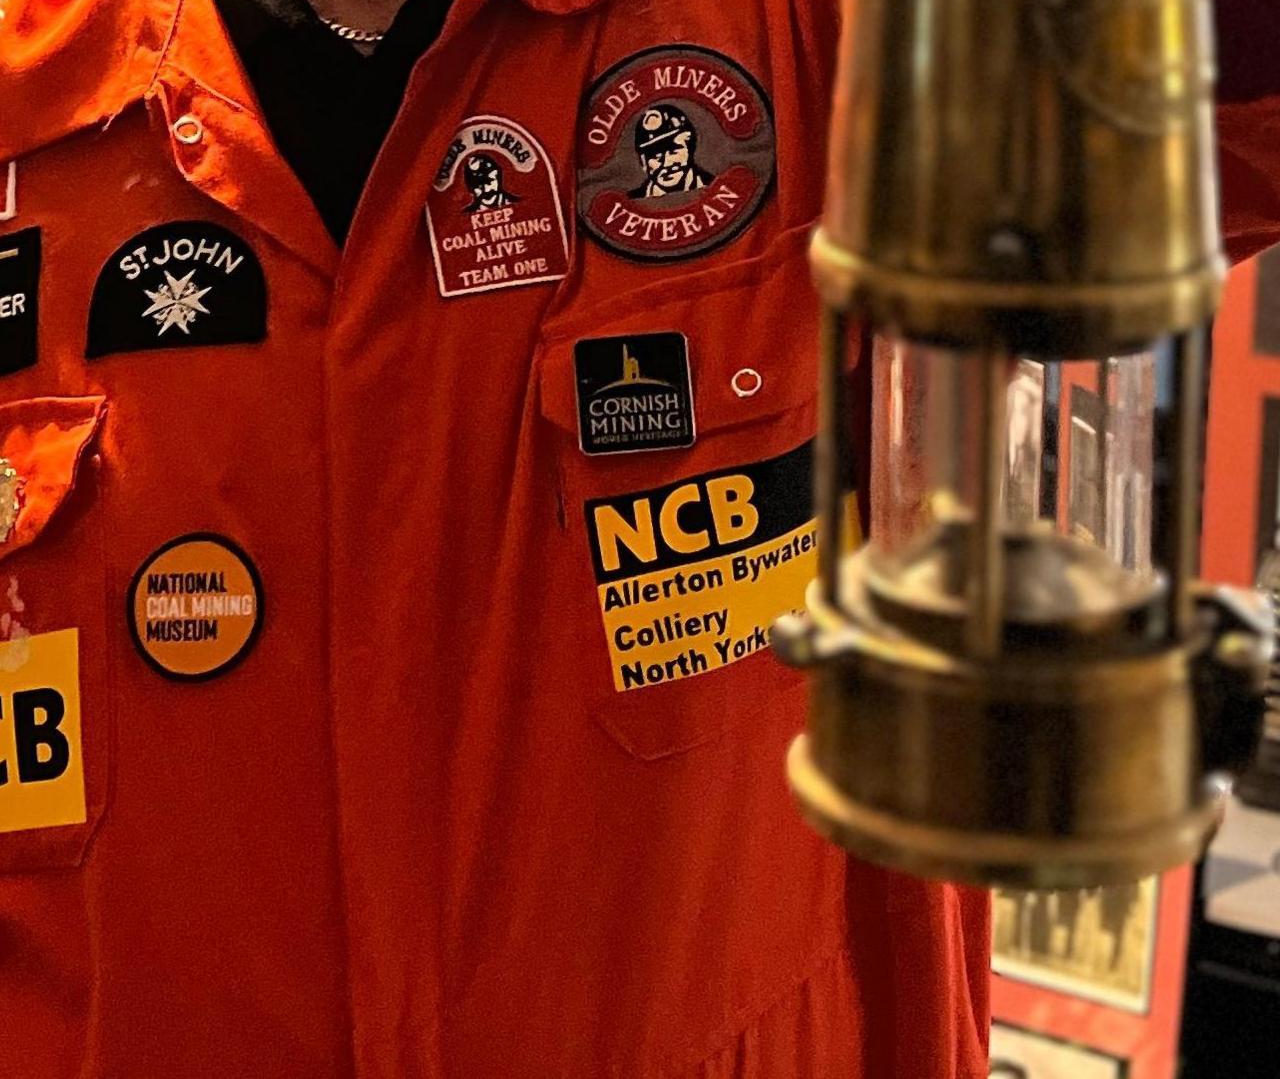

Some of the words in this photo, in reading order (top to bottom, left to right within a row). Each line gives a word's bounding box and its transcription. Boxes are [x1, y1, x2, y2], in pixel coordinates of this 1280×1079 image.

[588, 81, 641, 145] OLDE
[654, 65, 747, 123] MINERS
[471, 208, 514, 229] KEEP
[602, 184, 740, 241] VETERAN
[442, 233, 487, 251] COAL
[490, 218, 552, 244] MINING
[153, 238, 244, 274] JOHN
[476, 240, 526, 263] ALIVE
[459, 265, 509, 288] TEAM
[514, 258, 548, 276] ONE
[589, 393, 679, 417] CORNISH
[591, 411, 681, 435] MINING
[594, 474, 759, 572] NCB
[147, 572, 227, 594] NATIONAL
[604, 563, 724, 613] Allerton
[731, 528, 817, 584] Bywater
[146, 596, 186, 619] COAL
[191, 594, 252, 617] MINING
[147, 619, 218, 642] MUSEUM
[614, 608, 729, 651] Colliery
[620, 650, 707, 690] North
[714, 625, 768, 663] York
